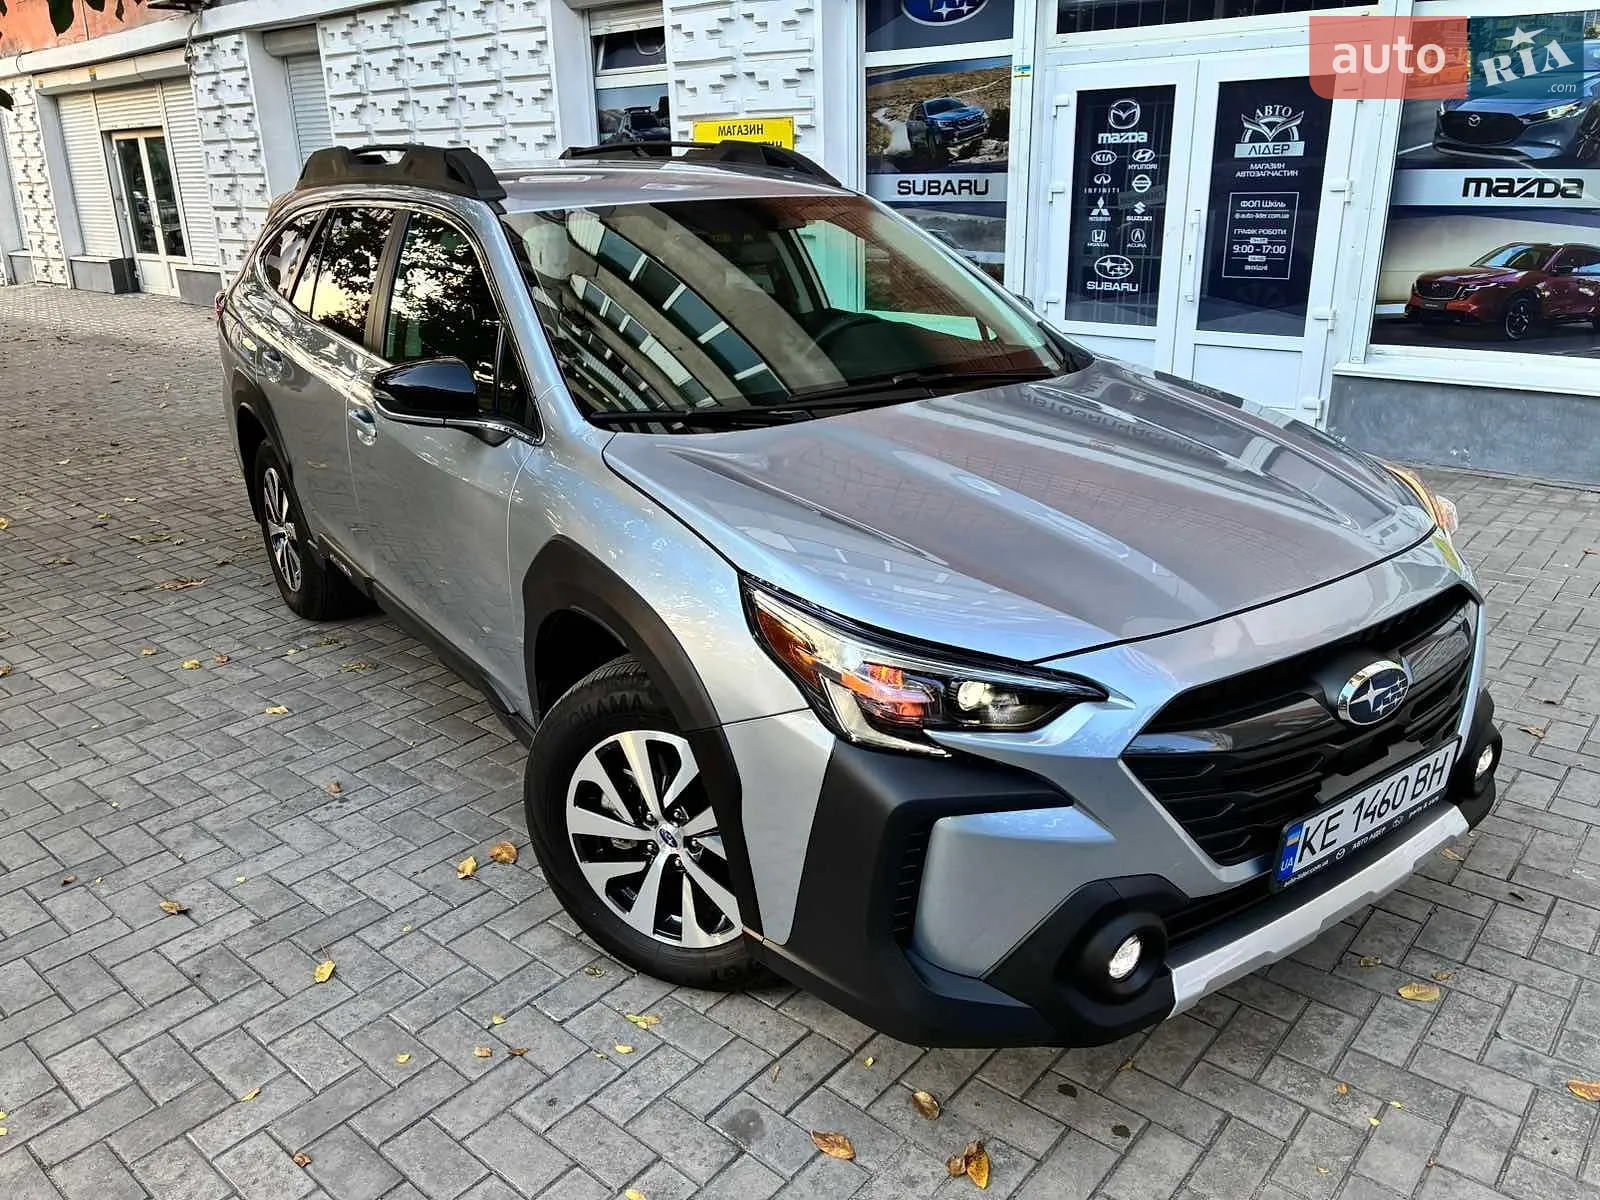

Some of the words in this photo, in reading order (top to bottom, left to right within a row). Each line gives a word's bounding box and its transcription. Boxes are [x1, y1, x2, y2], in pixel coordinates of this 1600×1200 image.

[1255, 104, 1292, 122] АВТО
[717, 123, 764, 137] МАГАЗИН
[1097, 131, 1148, 145] mazda
[1248, 144, 1290, 156] ЛІДЕР
[1095, 153, 1113, 162] KIA
[1249, 162, 1286, 171] МАГАЗИН
[1235, 170, 1299, 179] АВТОЗАПЧАСТИН
[897, 179, 990, 196] SUBARU
[1084, 187, 1120, 195] INFINITI
[1462, 176, 1585, 200] mazda
[1240, 200, 1261, 208] ФОП
[1232, 244, 1254, 253] 9:00
[1262, 244, 1287, 254] 17:00
[1086, 281, 1139, 292] SUBARU
[1297, 809, 1344, 864] KE
[1352, 774, 1409, 833] 1460
[1280, 855, 1294, 871] UA
